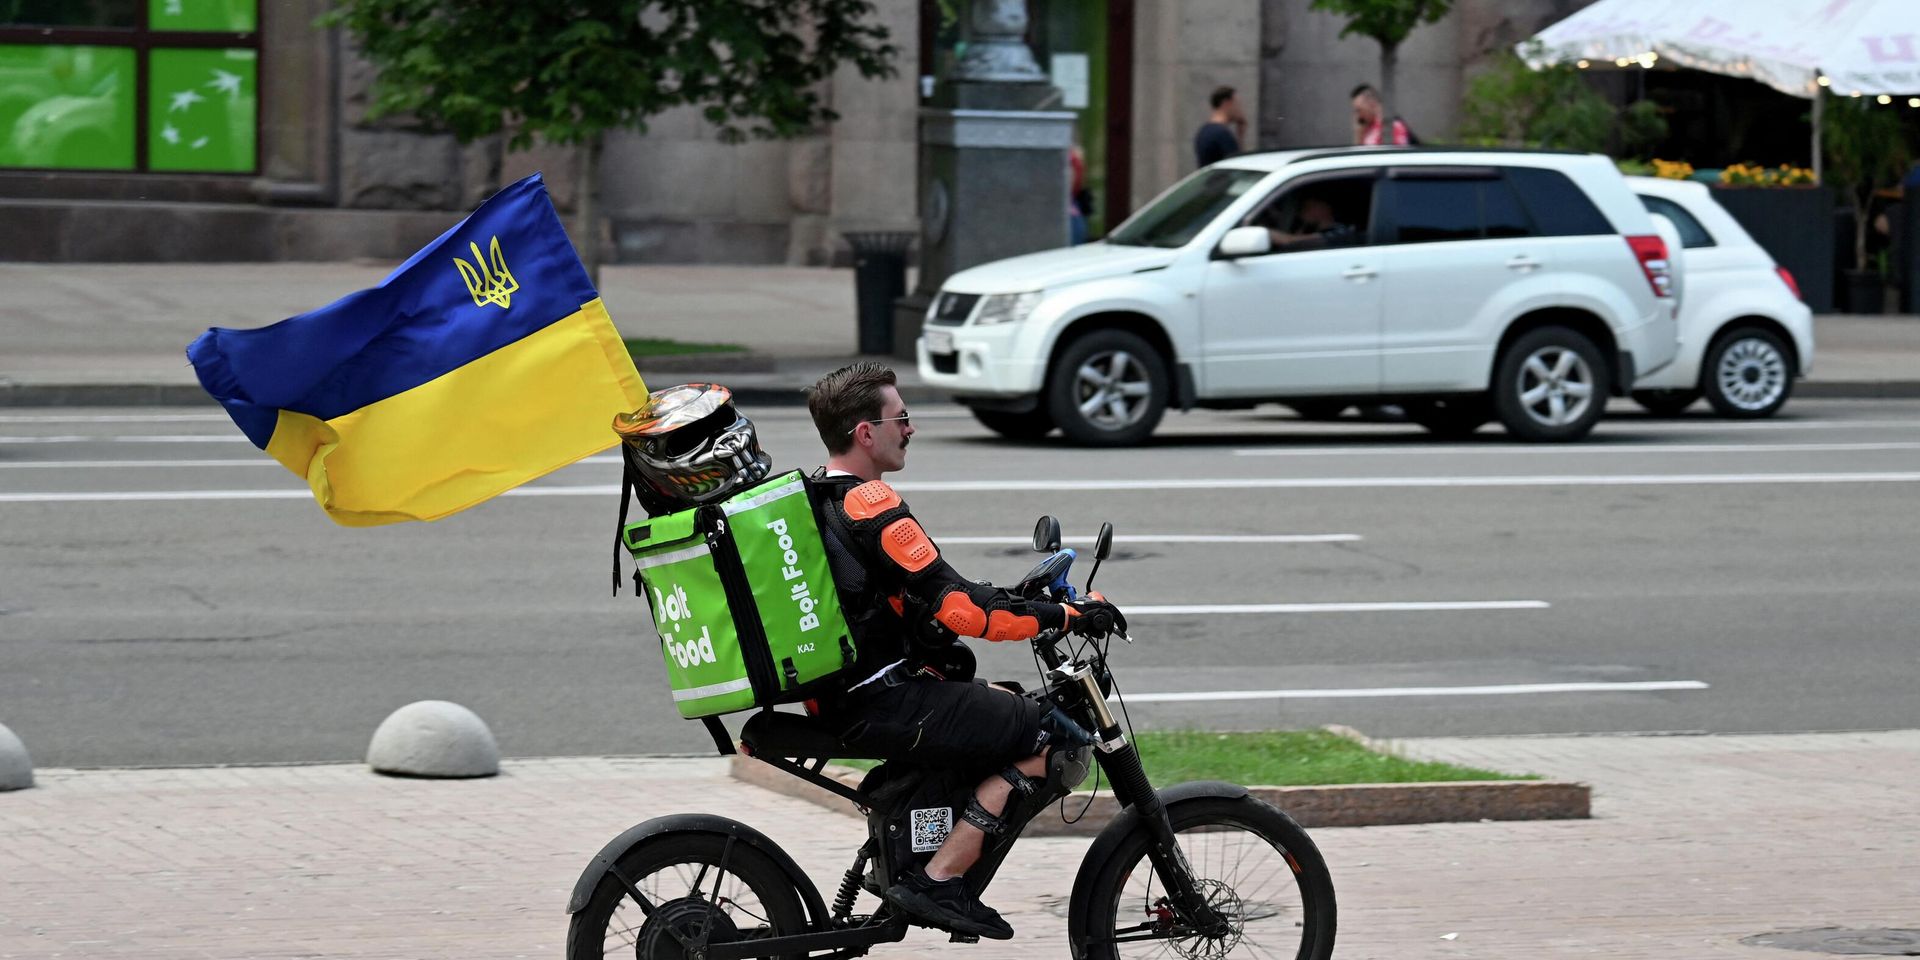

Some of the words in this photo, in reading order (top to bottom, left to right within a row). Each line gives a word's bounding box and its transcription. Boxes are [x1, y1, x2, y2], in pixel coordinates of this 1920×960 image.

[766, 517, 803, 581] Food
[653, 583, 692, 632] Bolt
[791, 581, 820, 632] Bolt
[663, 625, 717, 669] Food
[797, 642, 815, 655] KA2
